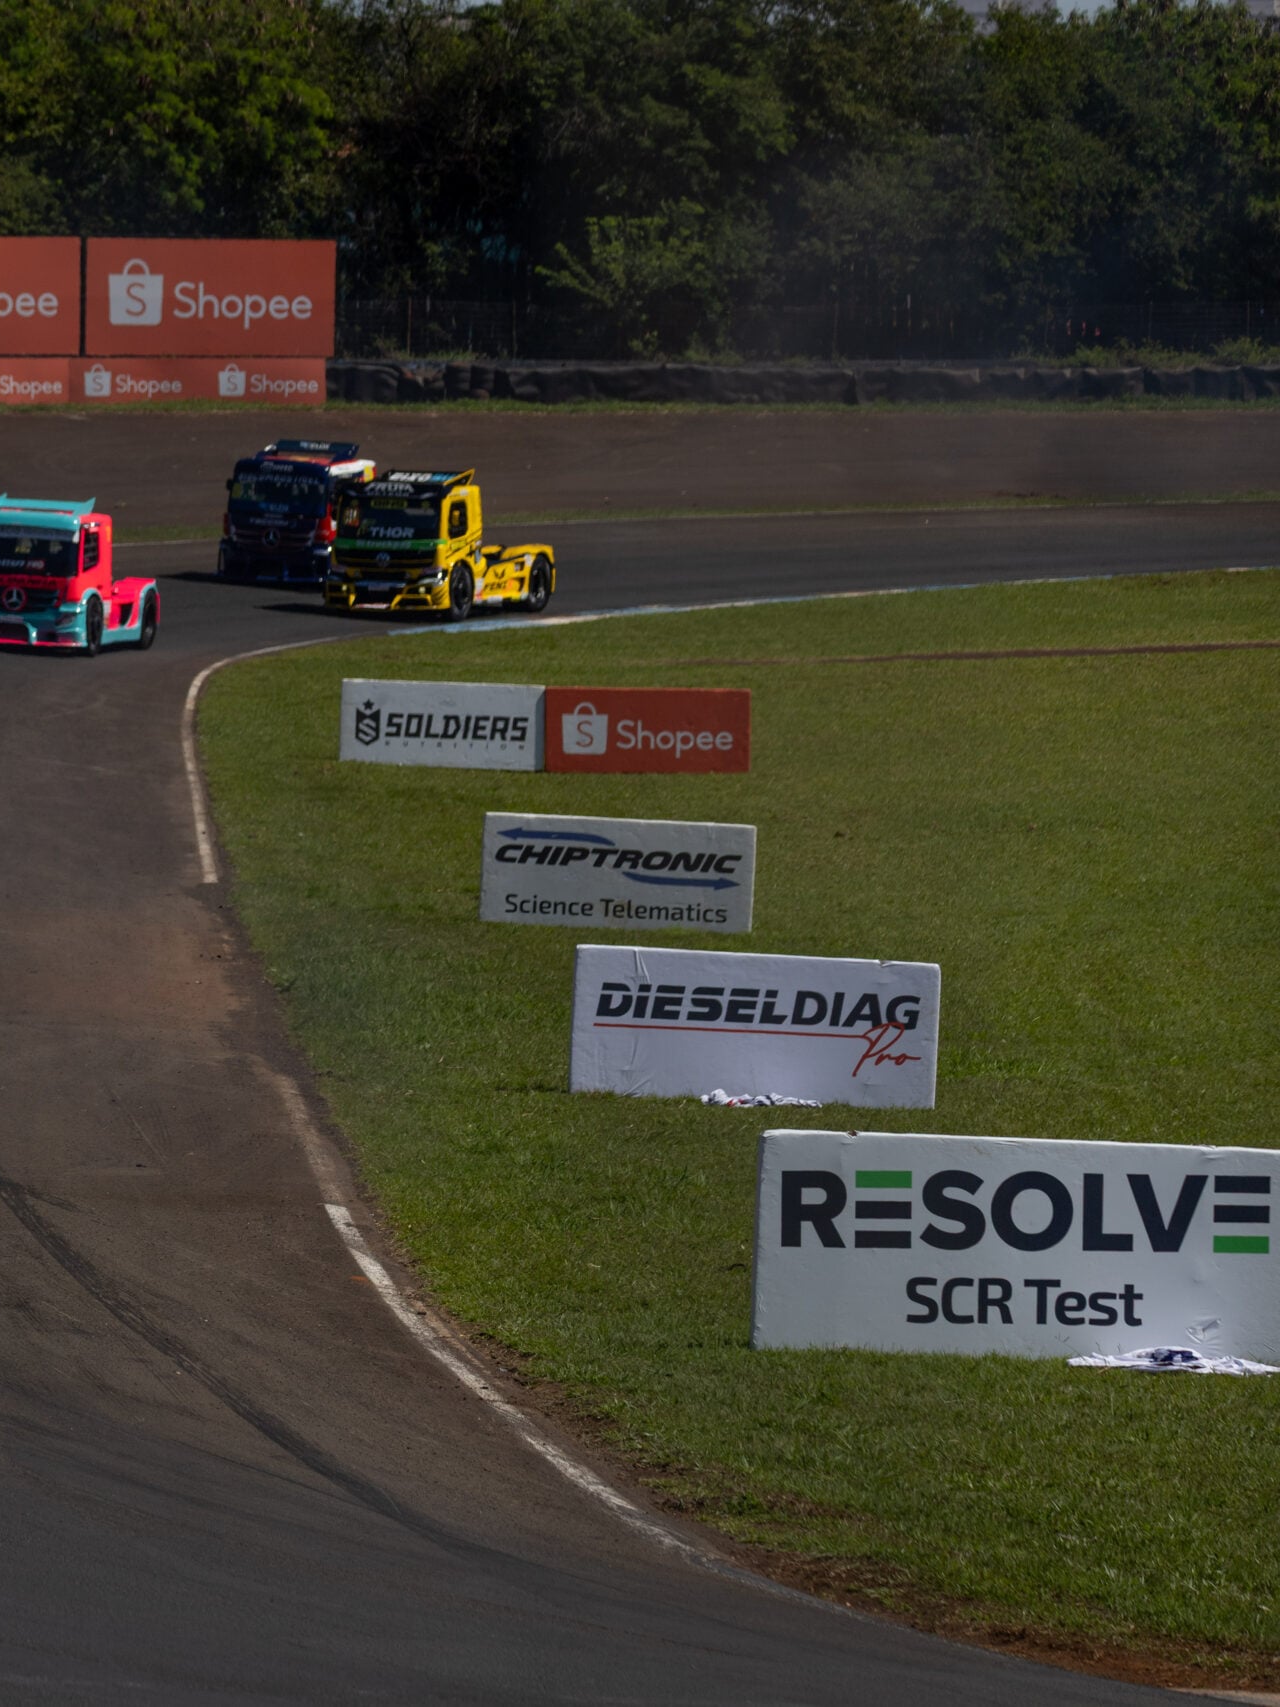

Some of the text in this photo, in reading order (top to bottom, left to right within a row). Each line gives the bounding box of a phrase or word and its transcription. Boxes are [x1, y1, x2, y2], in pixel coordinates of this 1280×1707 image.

[173, 281, 314, 330] Shopee
[115, 374, 183, 401] Shopee
[250, 374, 319, 402] Shopee
[370, 526, 416, 538] THOR
[385, 713, 529, 742] SOLDIERS
[616, 719, 733, 759] Shopee
[495, 844, 741, 875] CHIPTRONIC
[505, 894, 728, 924] Science Telematics
[596, 981, 921, 1031] DIESELDIAG
[781, 1170, 1271, 1254] RESOLVE
[906, 1277, 1144, 1327] SCR Test
